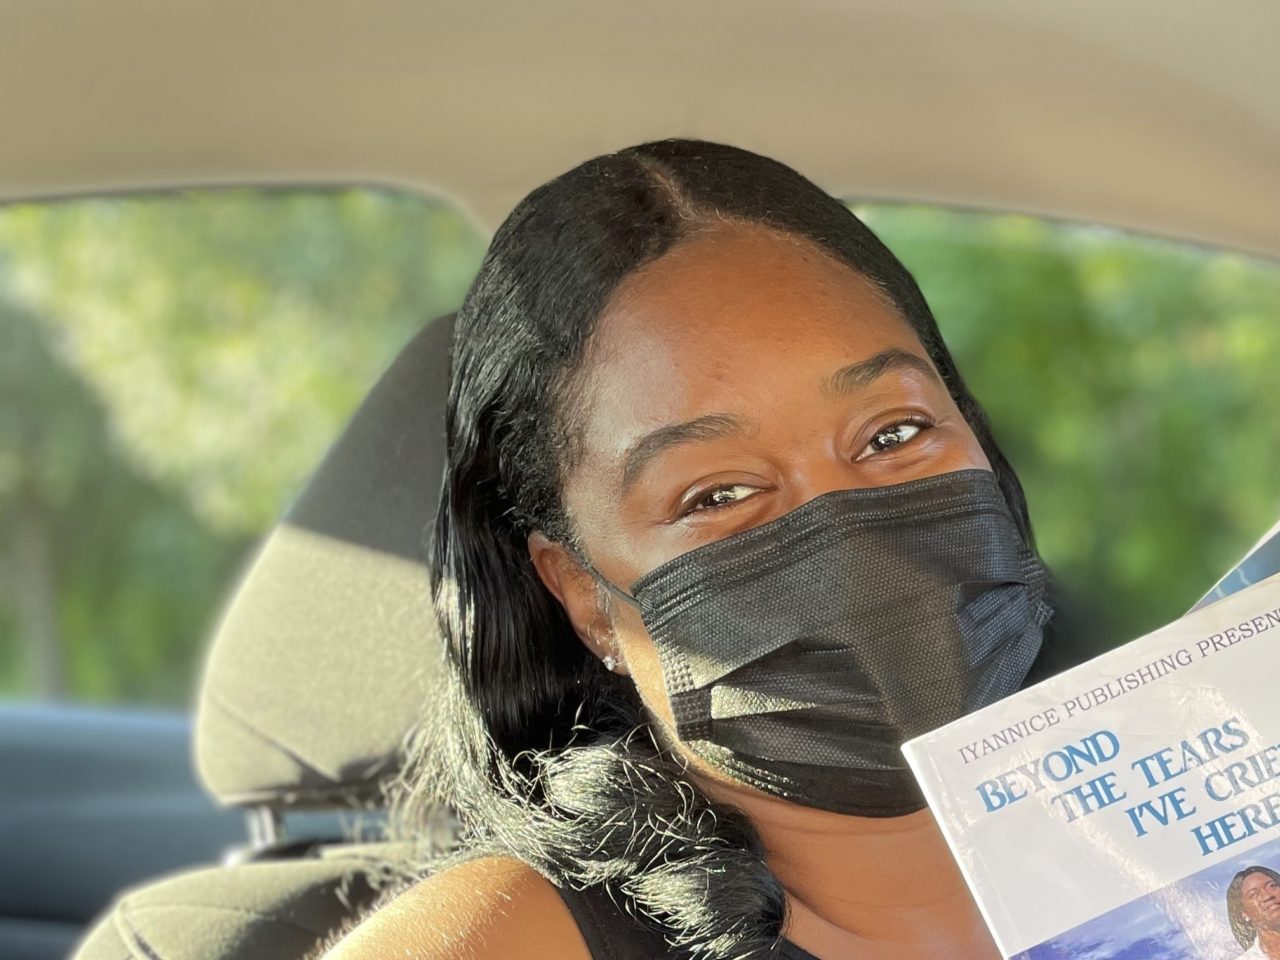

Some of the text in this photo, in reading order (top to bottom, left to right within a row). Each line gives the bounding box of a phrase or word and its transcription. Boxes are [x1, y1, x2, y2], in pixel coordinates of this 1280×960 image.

[958, 708, 1060, 765] IYANNICE
[1063, 648, 1194, 725] PUBLISHING
[975, 729, 1121, 813] BEYOND
[1051, 716, 1250, 824] THE TEARS
[1125, 786, 1197, 838] I'VE
